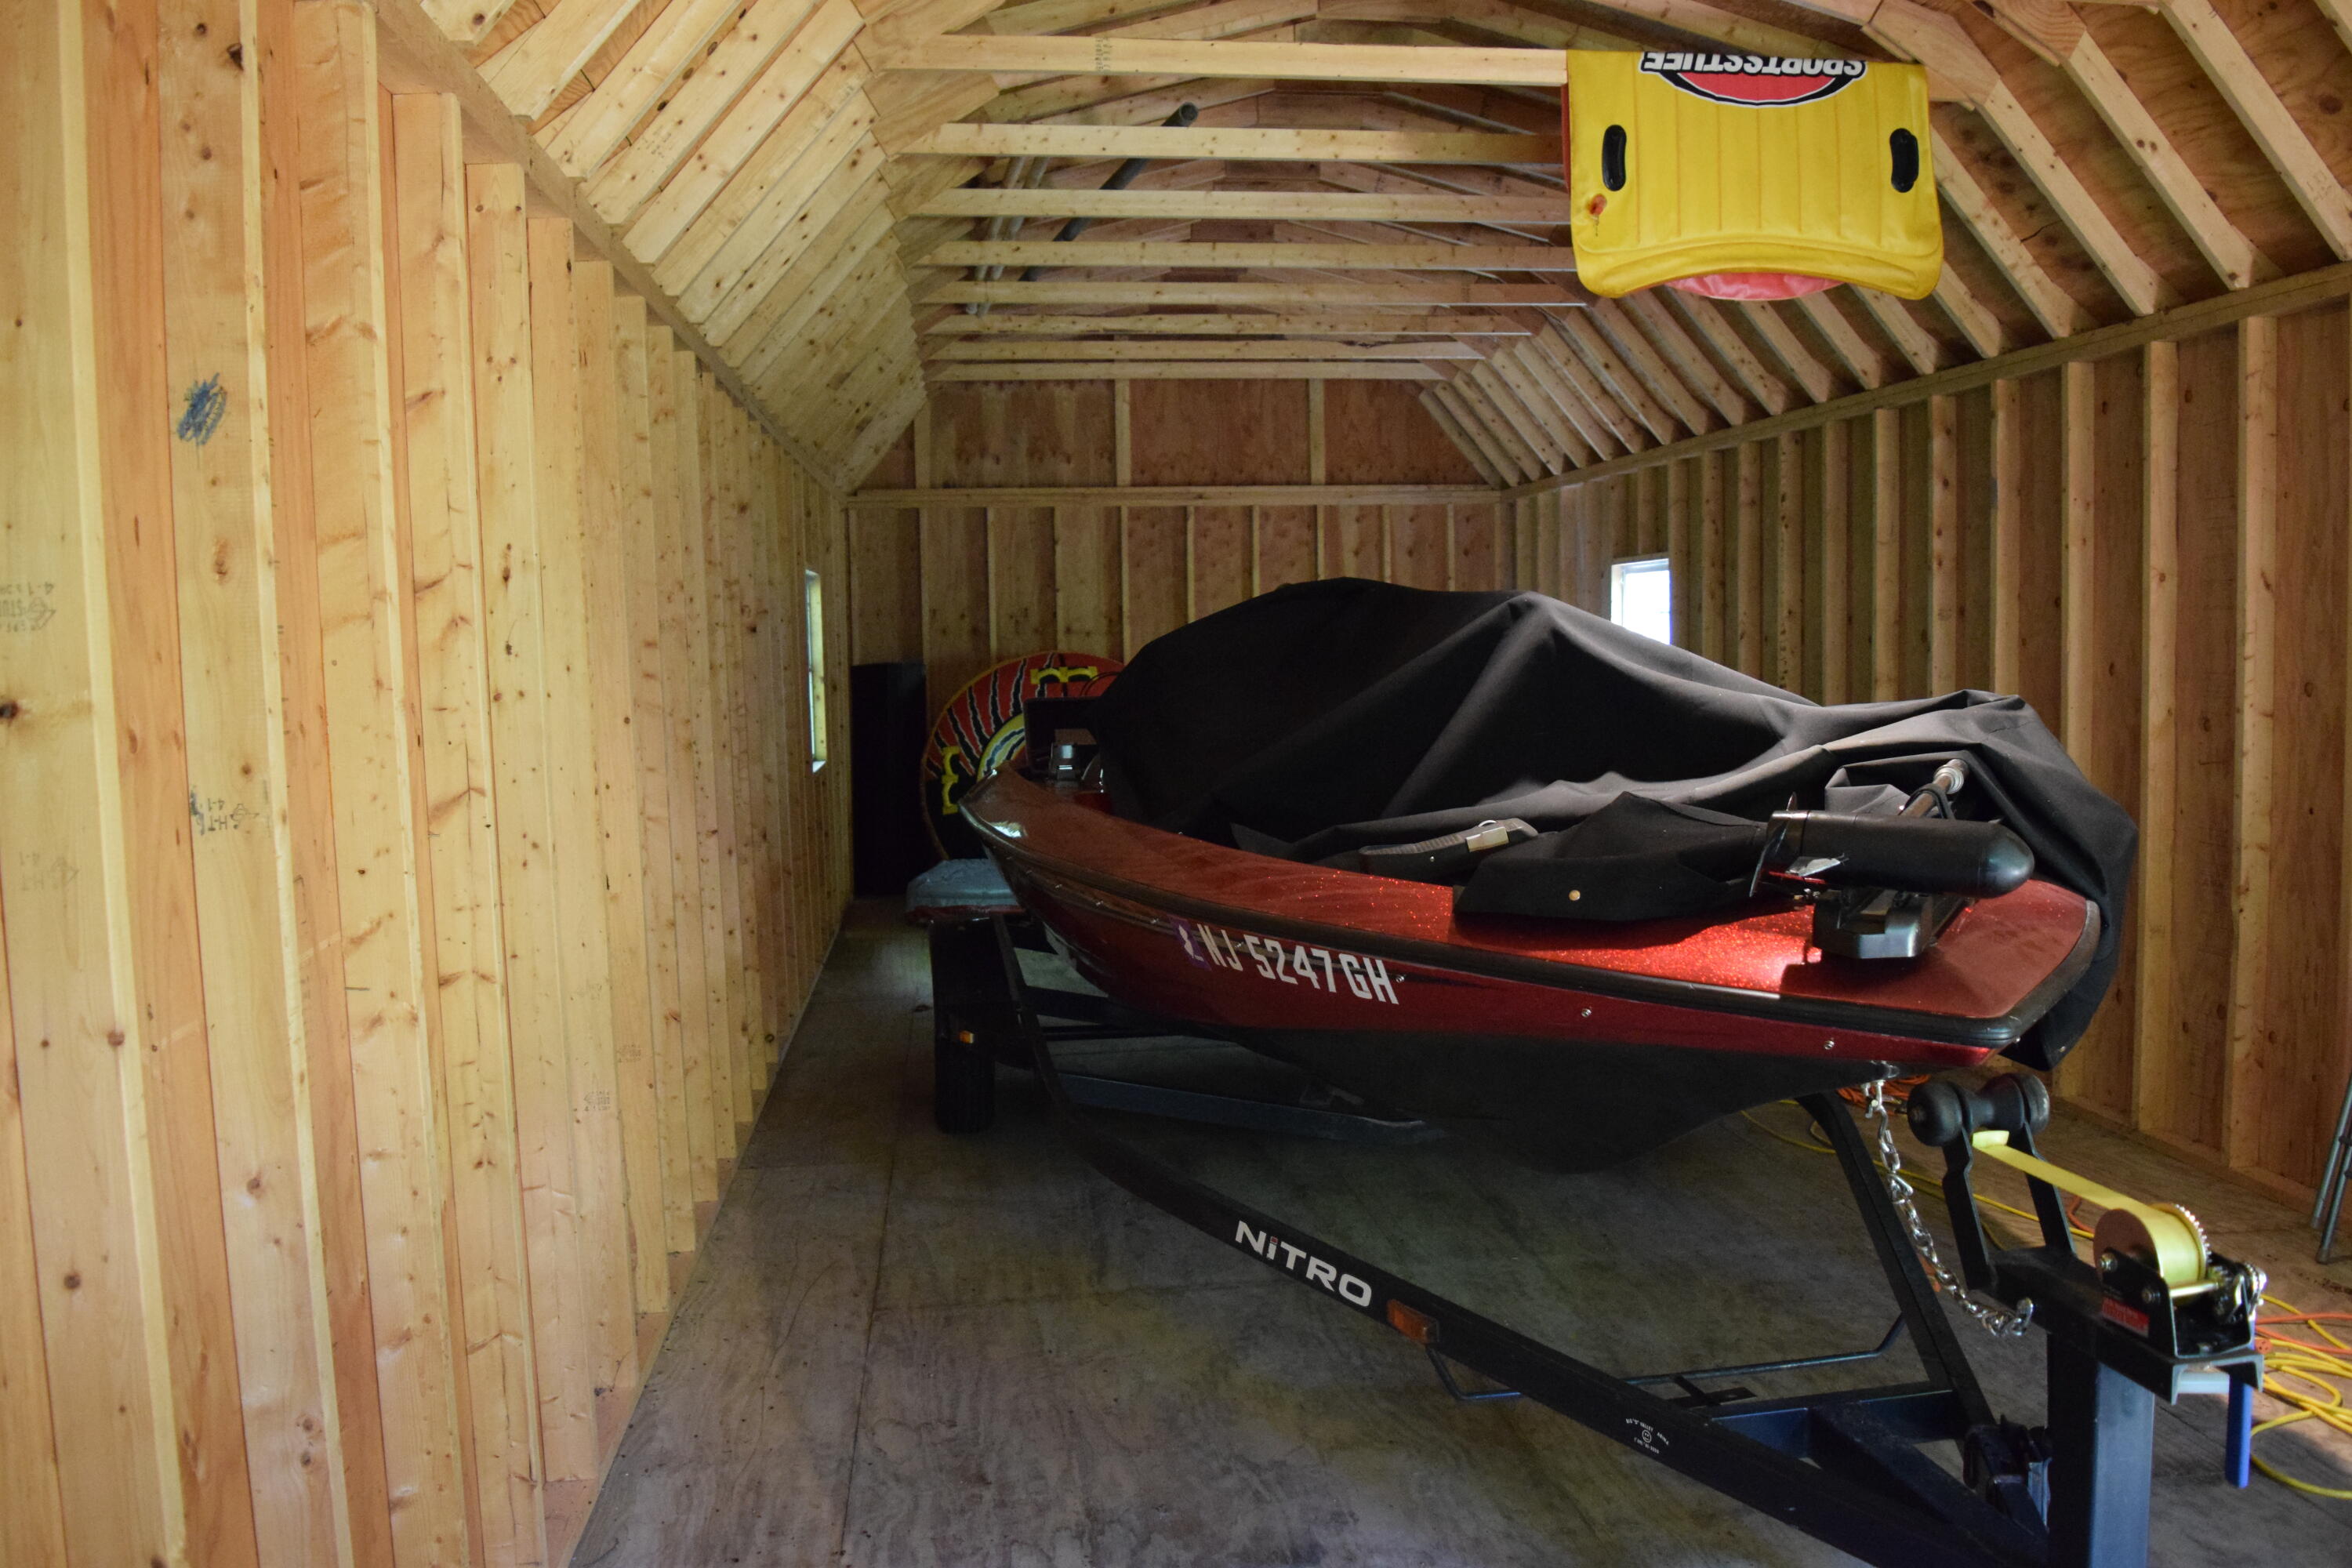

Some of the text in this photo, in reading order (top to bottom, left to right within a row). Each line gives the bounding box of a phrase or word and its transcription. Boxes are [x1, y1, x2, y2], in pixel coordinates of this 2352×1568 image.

[1196, 923, 1399, 1005] NJ 5247 GH
